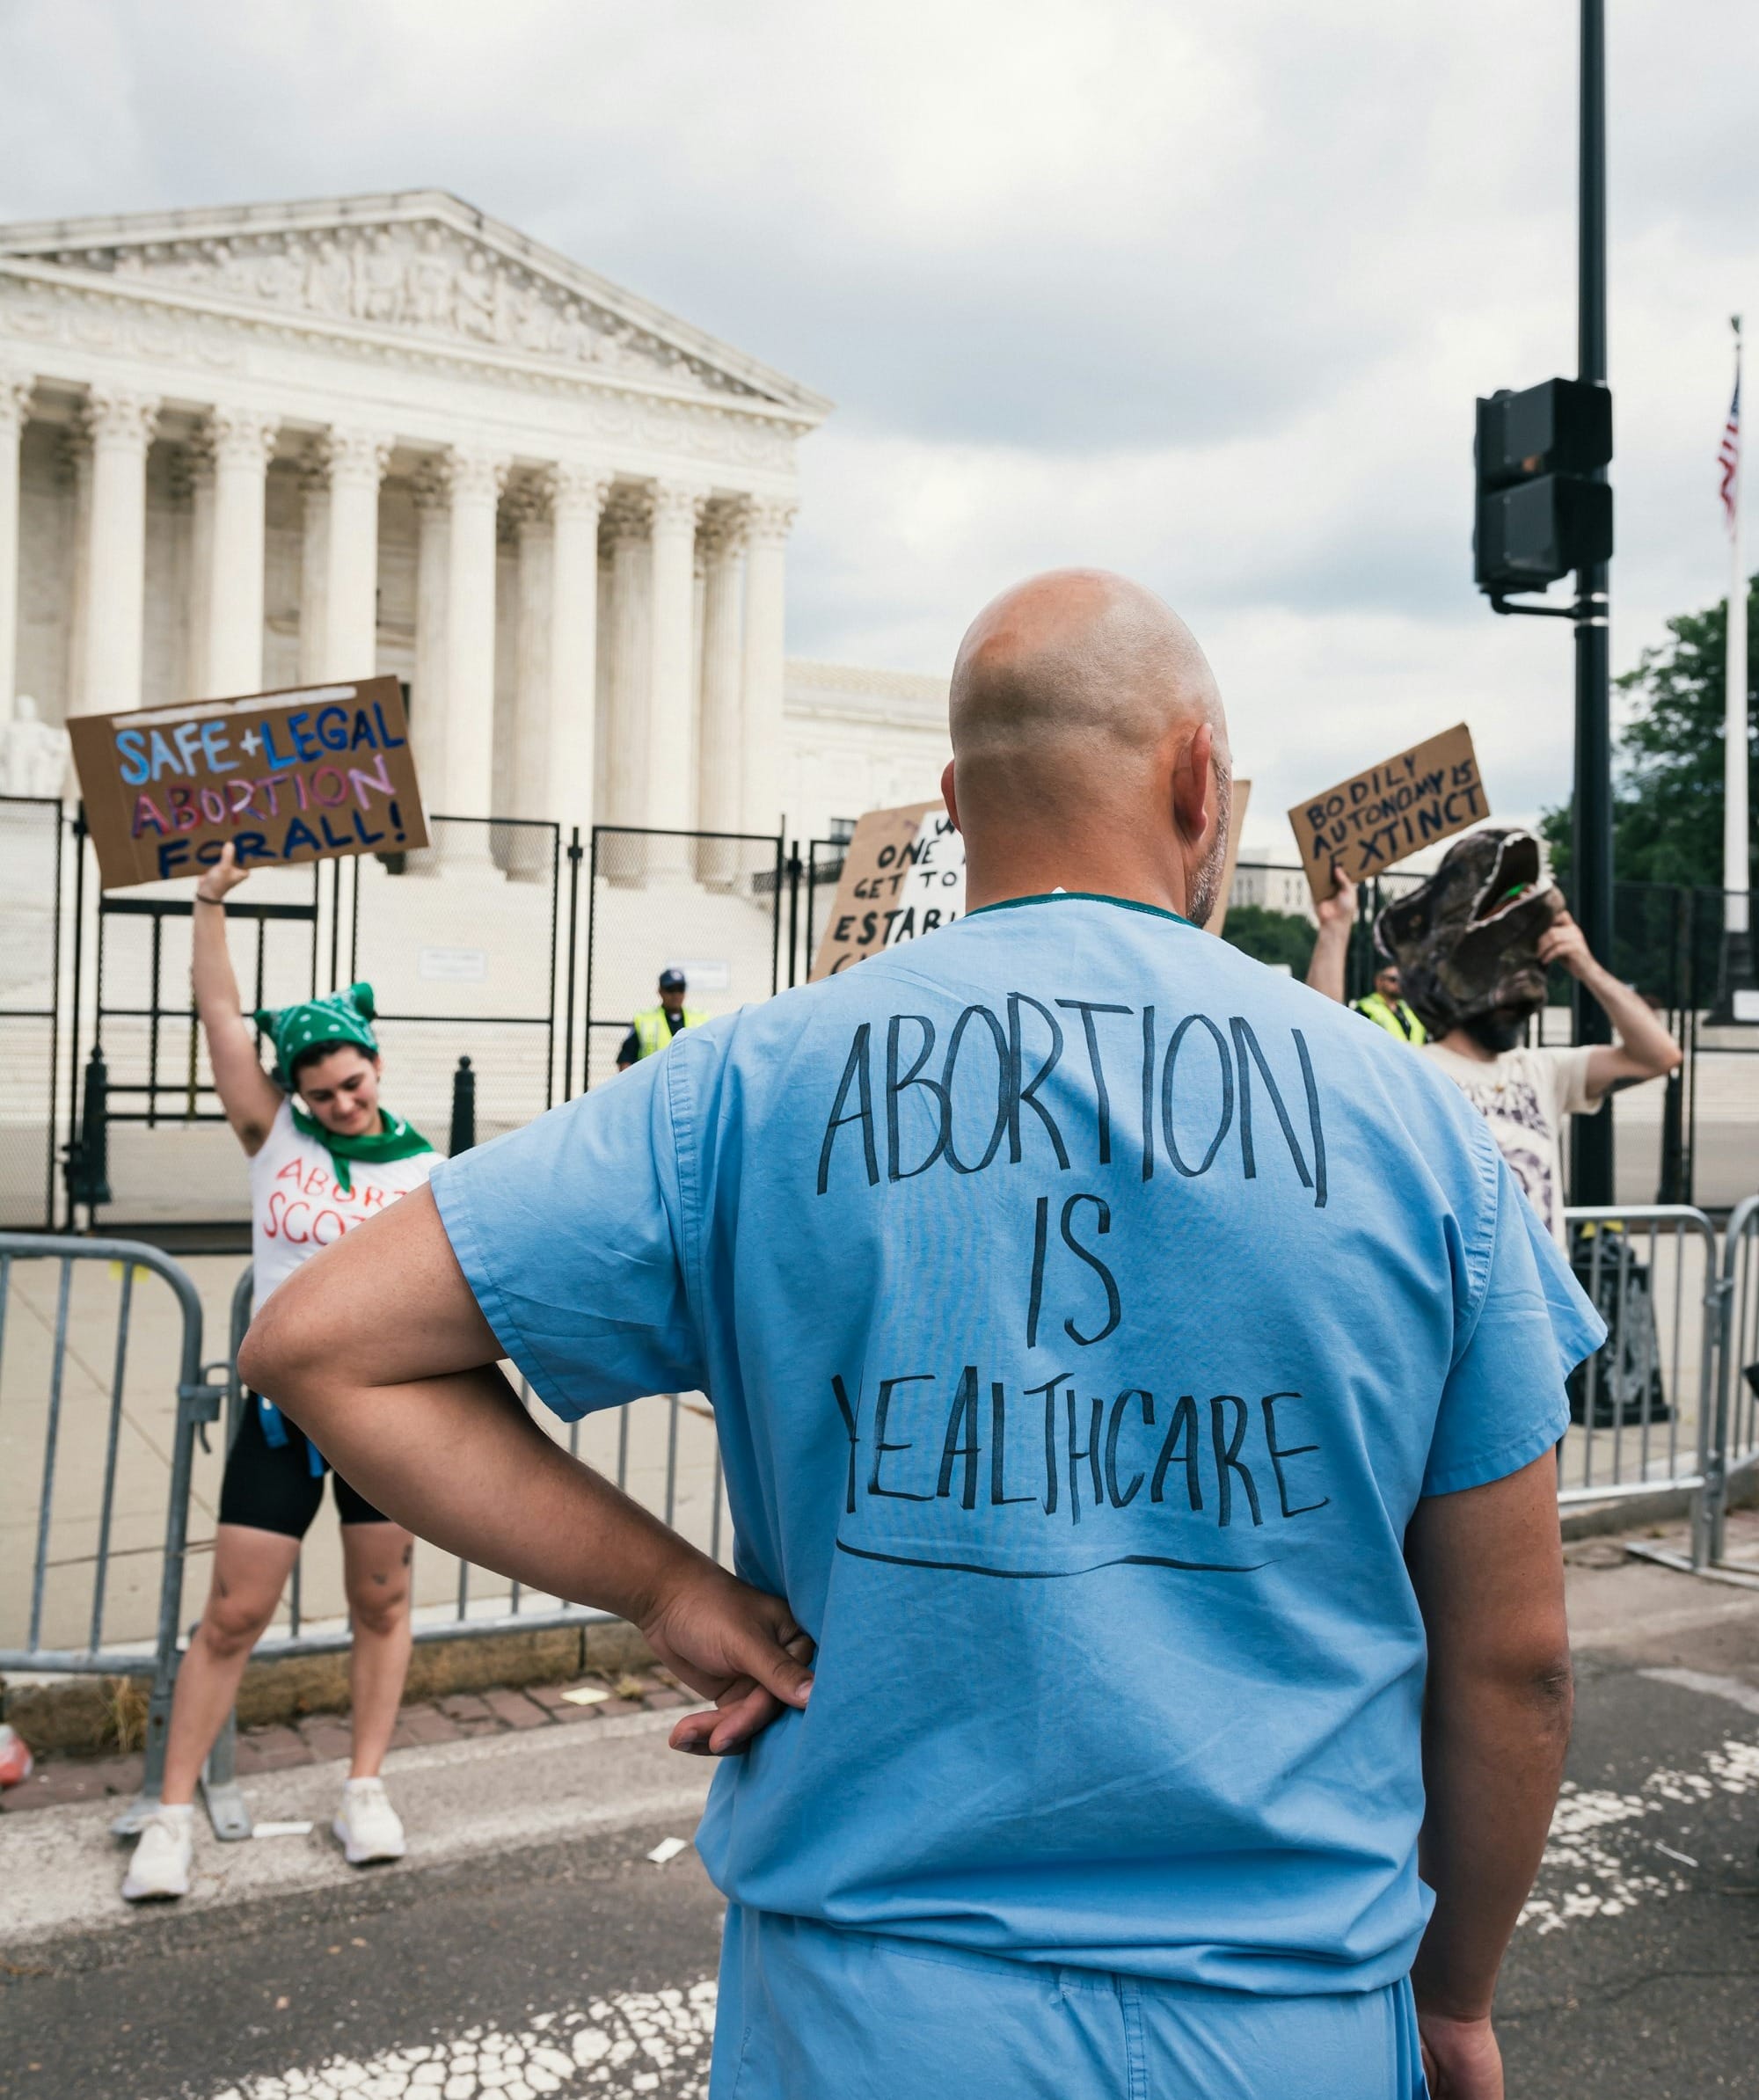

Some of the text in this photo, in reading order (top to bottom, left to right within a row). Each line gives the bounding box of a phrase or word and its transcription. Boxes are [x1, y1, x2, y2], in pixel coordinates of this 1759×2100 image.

[115, 721, 241, 785] SAFE
[259, 701, 405, 770] LEGAL
[131, 754, 397, 839] ABORTION
[1306, 754, 1417, 831] BODILY
[1312, 759, 1474, 859] AUTONOMY IS
[1330, 781, 1482, 883] EXTINCT
[854, 871, 957, 900] GET TO
[877, 837, 940, 869] ONE
[817, 991, 1328, 1208] ABORTION
[263, 1191, 366, 1246] SCO
[276, 1156, 408, 1208] ABOR
[1026, 1193, 1121, 1349] IS
